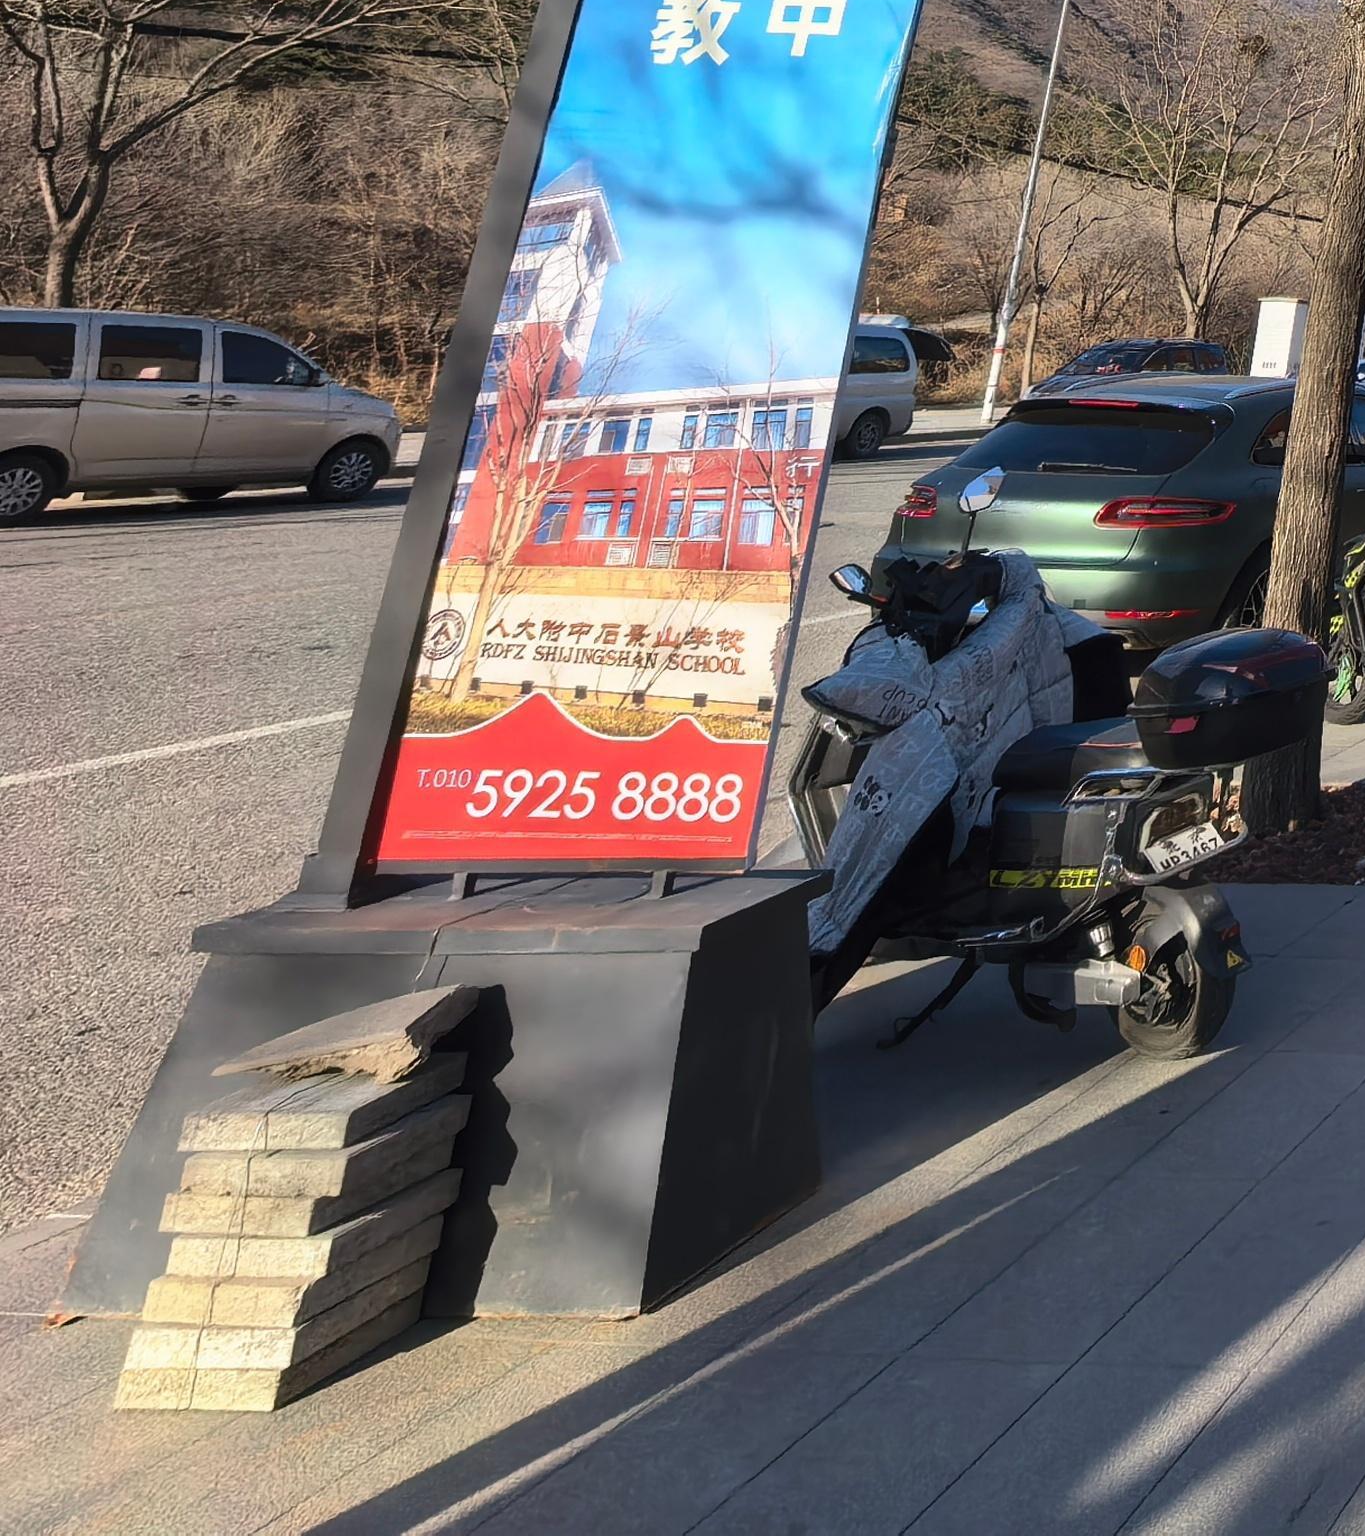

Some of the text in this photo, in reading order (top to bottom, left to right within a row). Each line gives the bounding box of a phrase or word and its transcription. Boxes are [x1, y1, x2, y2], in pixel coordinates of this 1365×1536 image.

[480, 642, 746, 676] RDFZ SHIJINGSHAN SCHOOL
[416, 768, 744, 824] T.010 5925 8888
